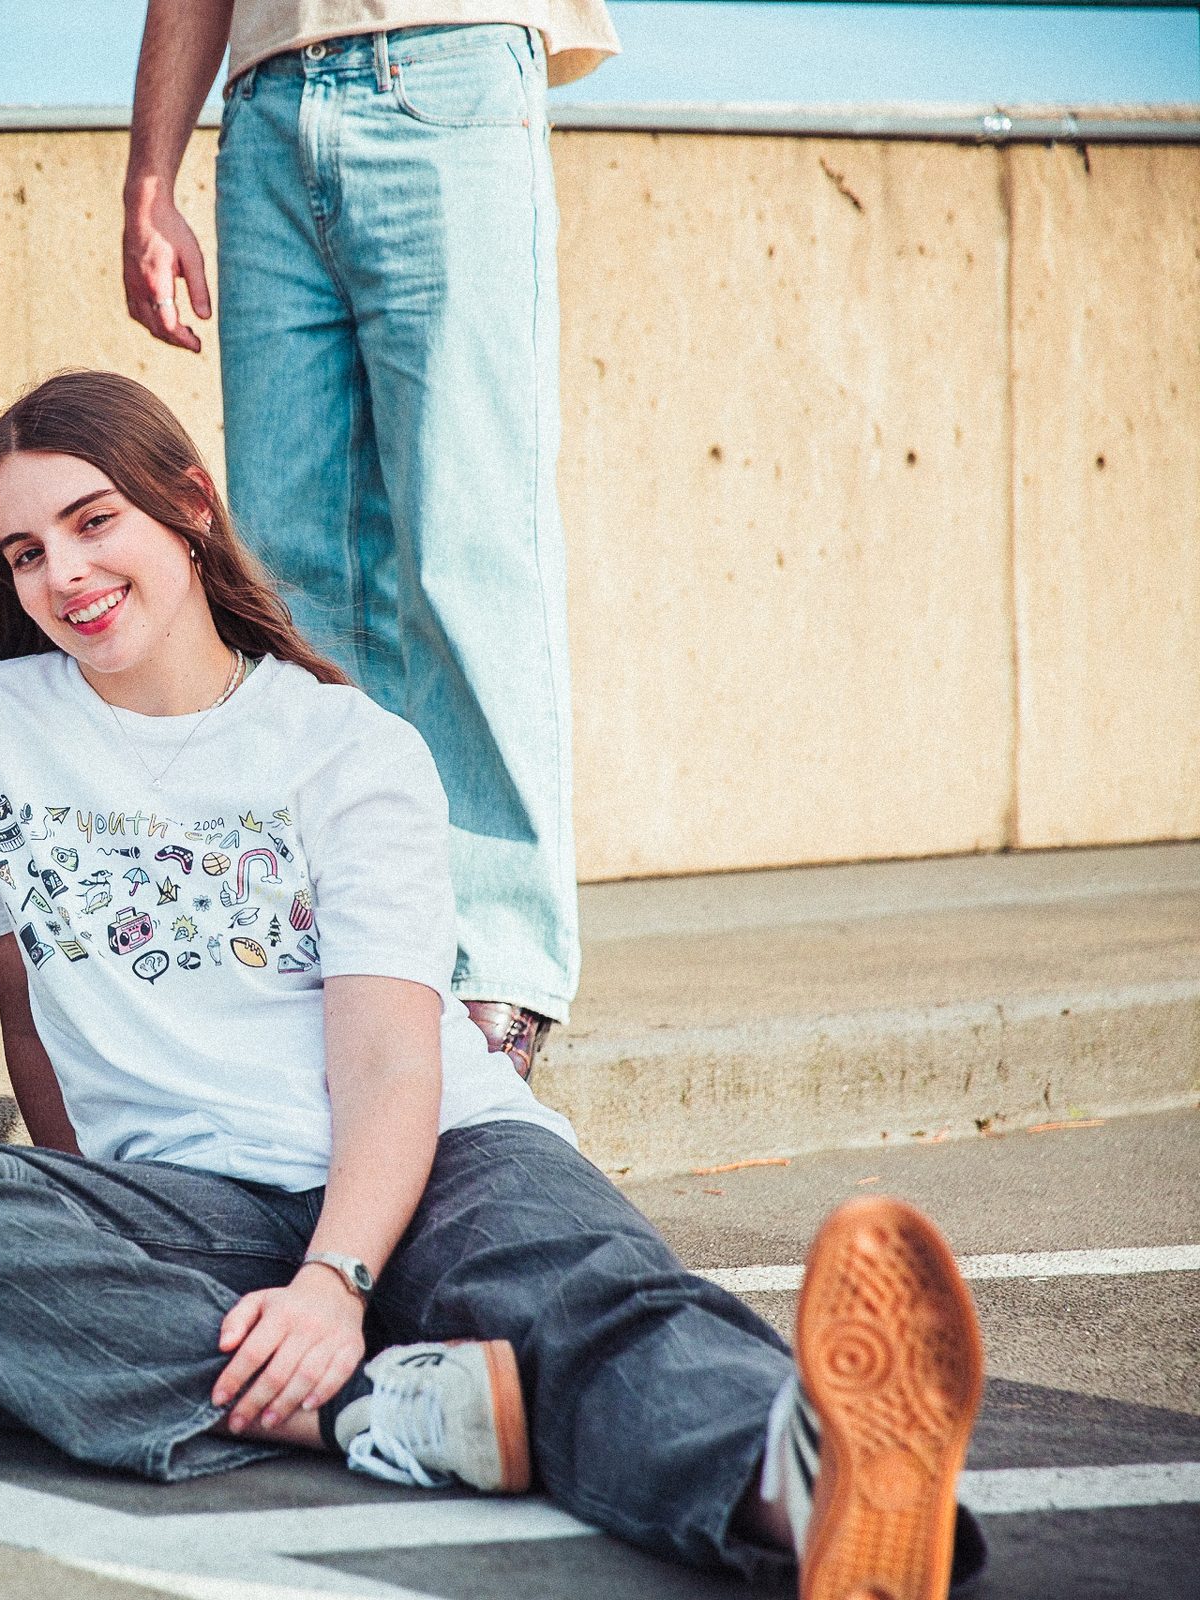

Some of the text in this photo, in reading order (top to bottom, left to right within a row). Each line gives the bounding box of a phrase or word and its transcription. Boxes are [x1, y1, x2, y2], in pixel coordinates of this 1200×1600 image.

[76, 810, 169, 843] youth
[193, 816, 225, 831] 2009
[31, 894, 46, 908] FUN
